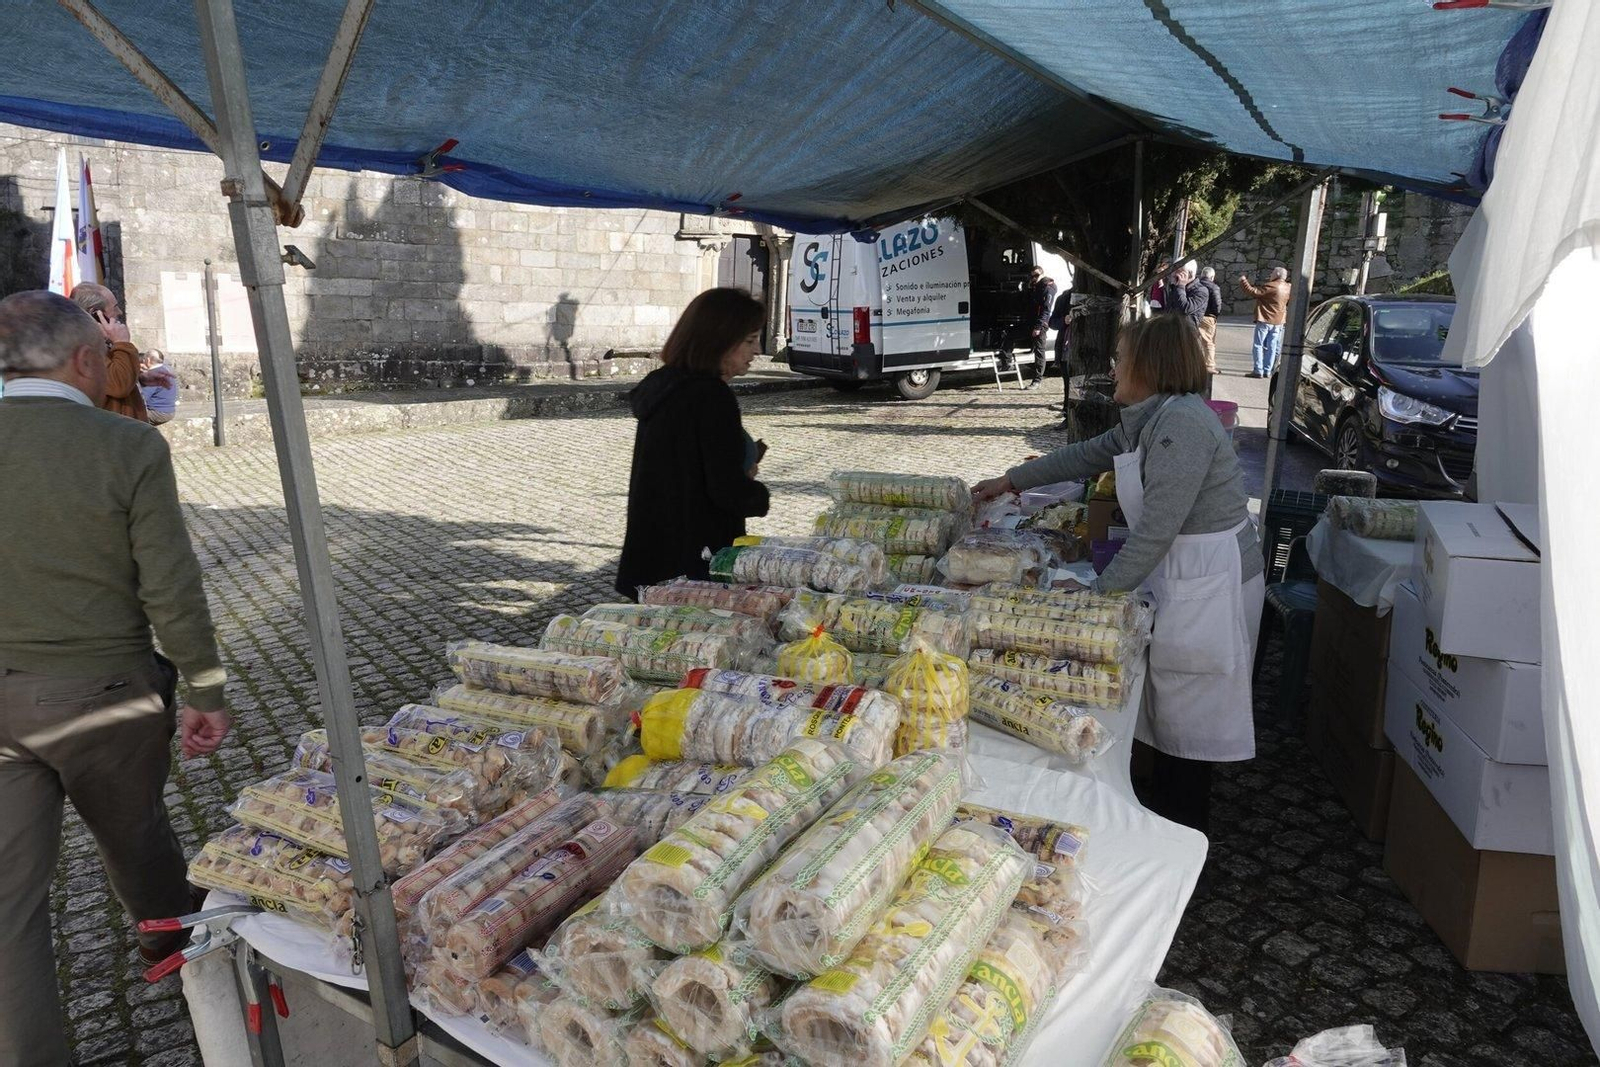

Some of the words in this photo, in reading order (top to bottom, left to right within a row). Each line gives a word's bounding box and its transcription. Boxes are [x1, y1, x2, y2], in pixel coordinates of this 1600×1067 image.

[878, 223, 939, 263] LAZO
[881, 245, 944, 278] ZACIONES
[896, 282, 918, 291] Sonido
[922, 293, 947, 303] alquiler
[1001, 717, 1030, 736] ancla
[1415, 702, 1444, 753] Regino
[249, 895, 288, 913] ancla
[976, 965, 1025, 1024] ancla
